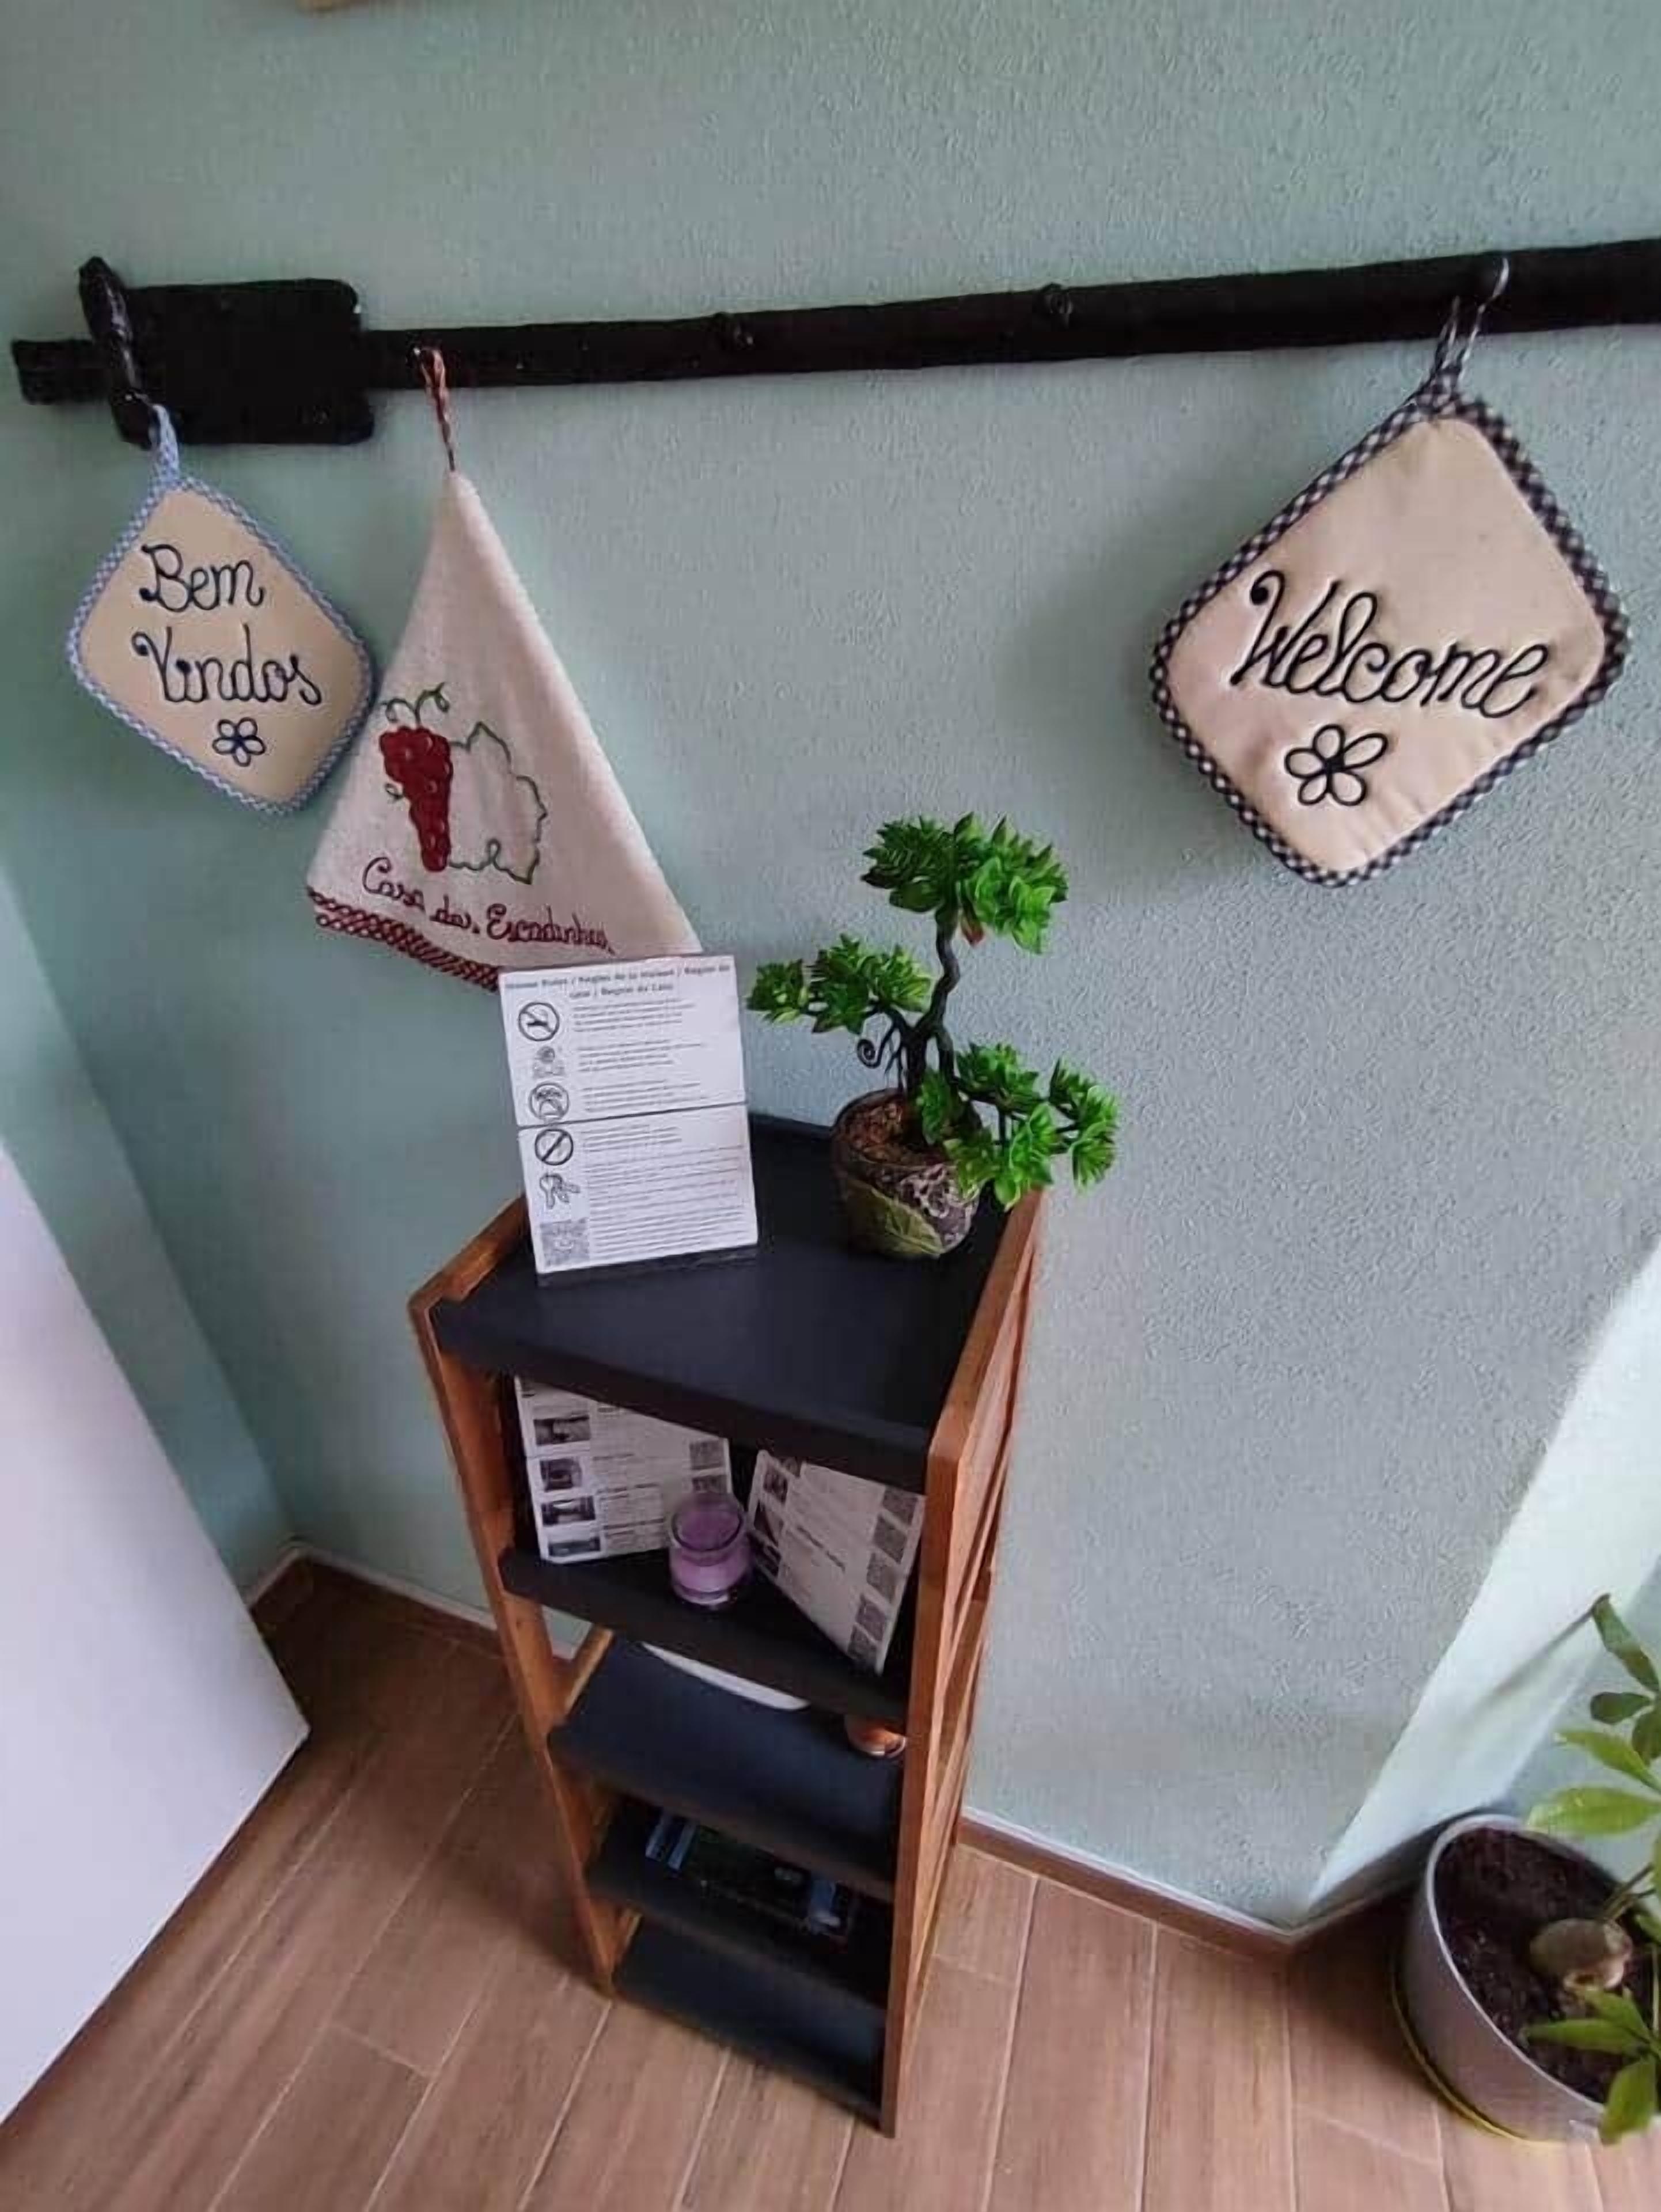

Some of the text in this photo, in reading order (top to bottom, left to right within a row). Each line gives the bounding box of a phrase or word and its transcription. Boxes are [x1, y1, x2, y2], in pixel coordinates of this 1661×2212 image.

[139, 543, 265, 612] Bem
[131, 622, 322, 706] Vindos
[1230, 570, 1548, 718] Welcome
[362, 856, 426, 915] Casa
